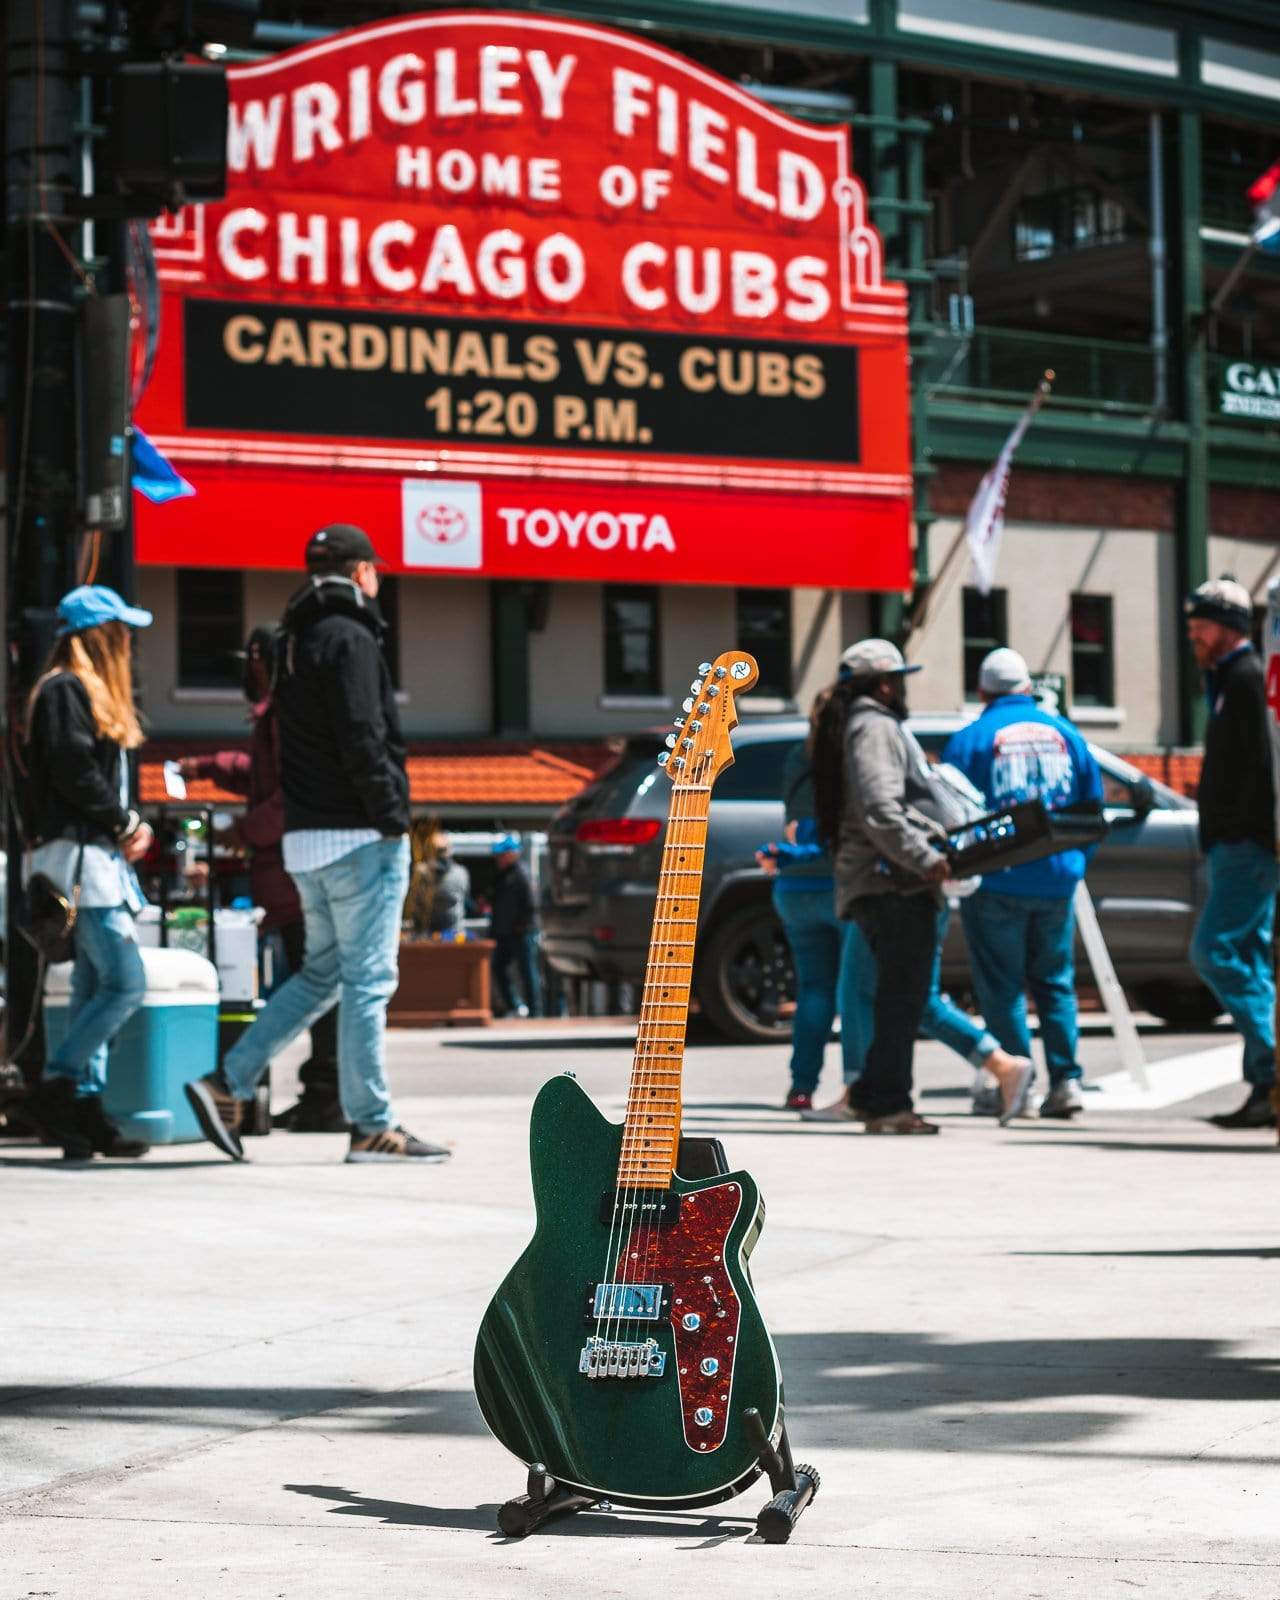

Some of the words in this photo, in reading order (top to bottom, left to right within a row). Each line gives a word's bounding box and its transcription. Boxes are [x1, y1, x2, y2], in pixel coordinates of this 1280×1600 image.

[226, 45, 577, 171] WRIGLEY
[612, 67, 828, 222] FIELD
[395, 144, 562, 201] HOME
[598, 164, 673, 211] OF
[217, 206, 586, 303] CHICAGO
[620, 240, 832, 323] CUBS
[223, 316, 561, 383] CARDINALS
[574, 338, 664, 389] VS.
[678, 346, 826, 399] CUBS
[425, 387, 538, 437] 1:20
[553, 395, 653, 443] P.M.
[497, 507, 677, 552] TOYOTA
